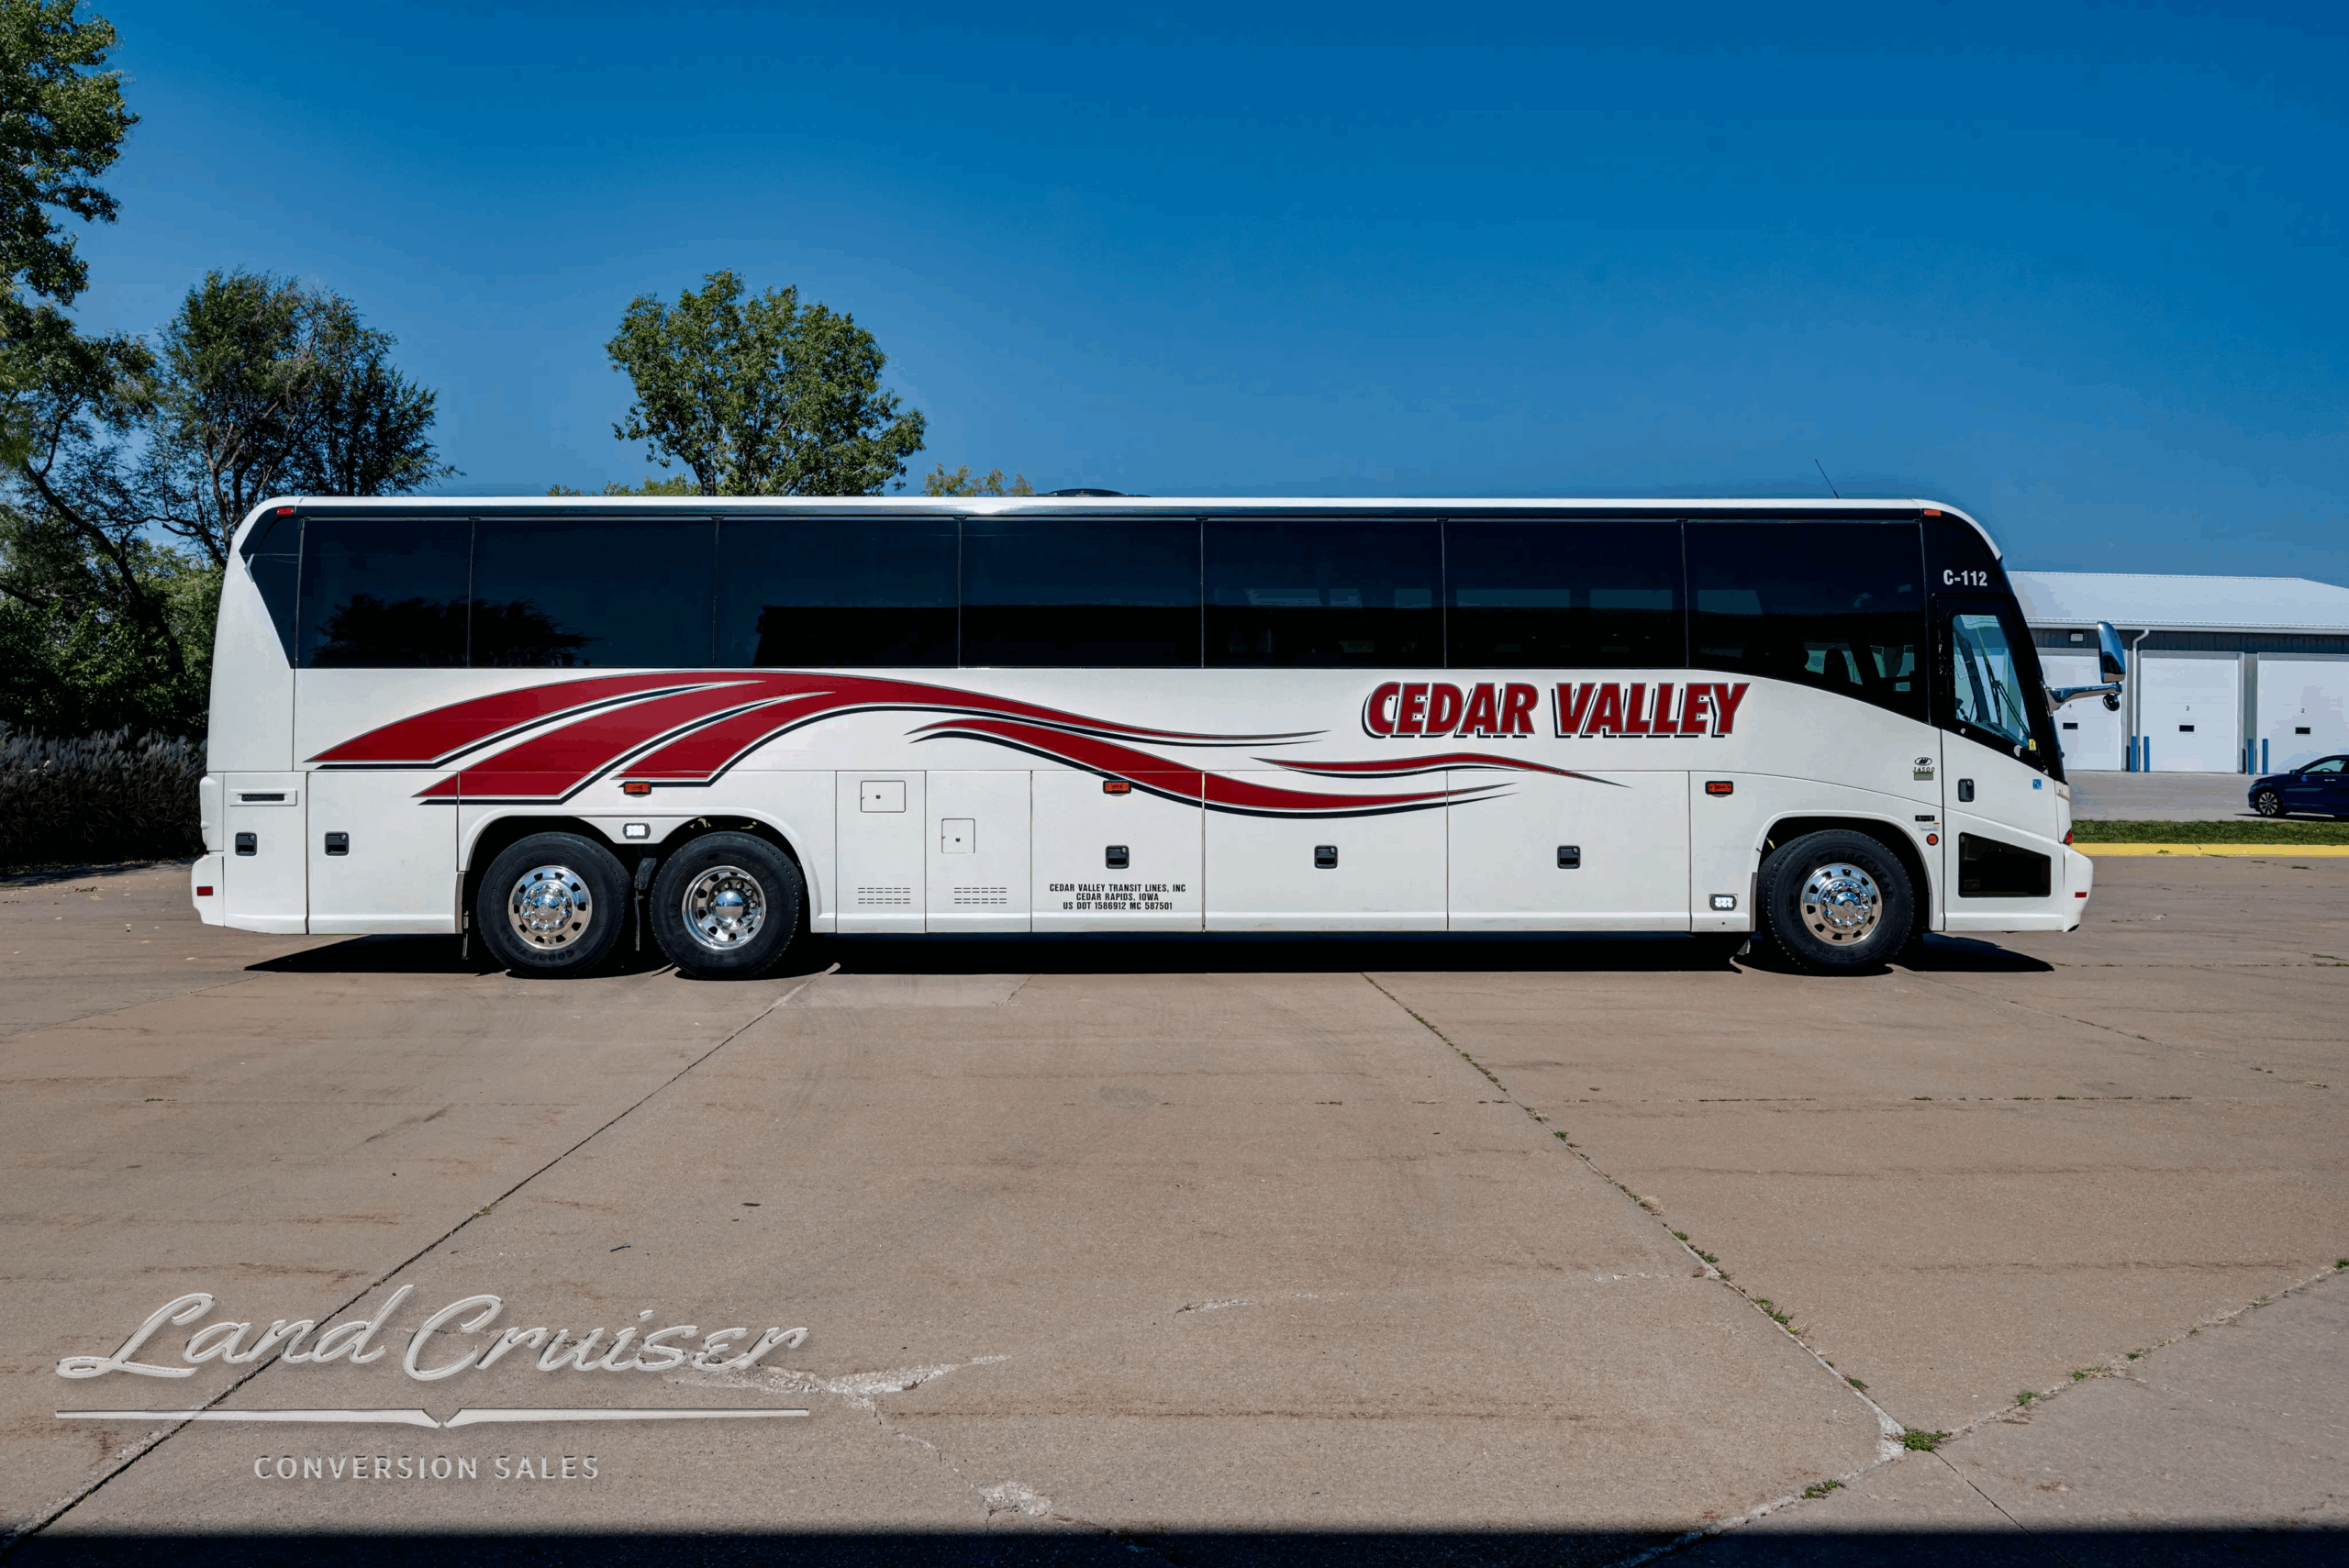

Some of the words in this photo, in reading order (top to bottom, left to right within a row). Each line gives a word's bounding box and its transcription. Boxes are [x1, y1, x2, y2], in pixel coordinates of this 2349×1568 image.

[1943, 569, 1987, 587] C-112
[1362, 682, 1539, 739] CEDAR
[1551, 682, 1751, 739] VALLEY
[1049, 883, 1075, 892] CEDAR
[1078, 884, 1106, 892] VALLEY
[1108, 884, 1142, 892] TRANSIT
[1144, 884, 1170, 893] LINES,
[1173, 884, 1186, 893] INC
[1075, 893, 1102, 901] CEDAR
[1105, 893, 1136, 901] RAPIDS,
[1139, 893, 1159, 901] IOWA
[1063, 901, 1074, 910] US
[1076, 901, 1092, 910] DOT
[1095, 901, 1127, 910] 1586912
[1130, 901, 1141, 910] MC
[1144, 901, 1173, 910] 587501
